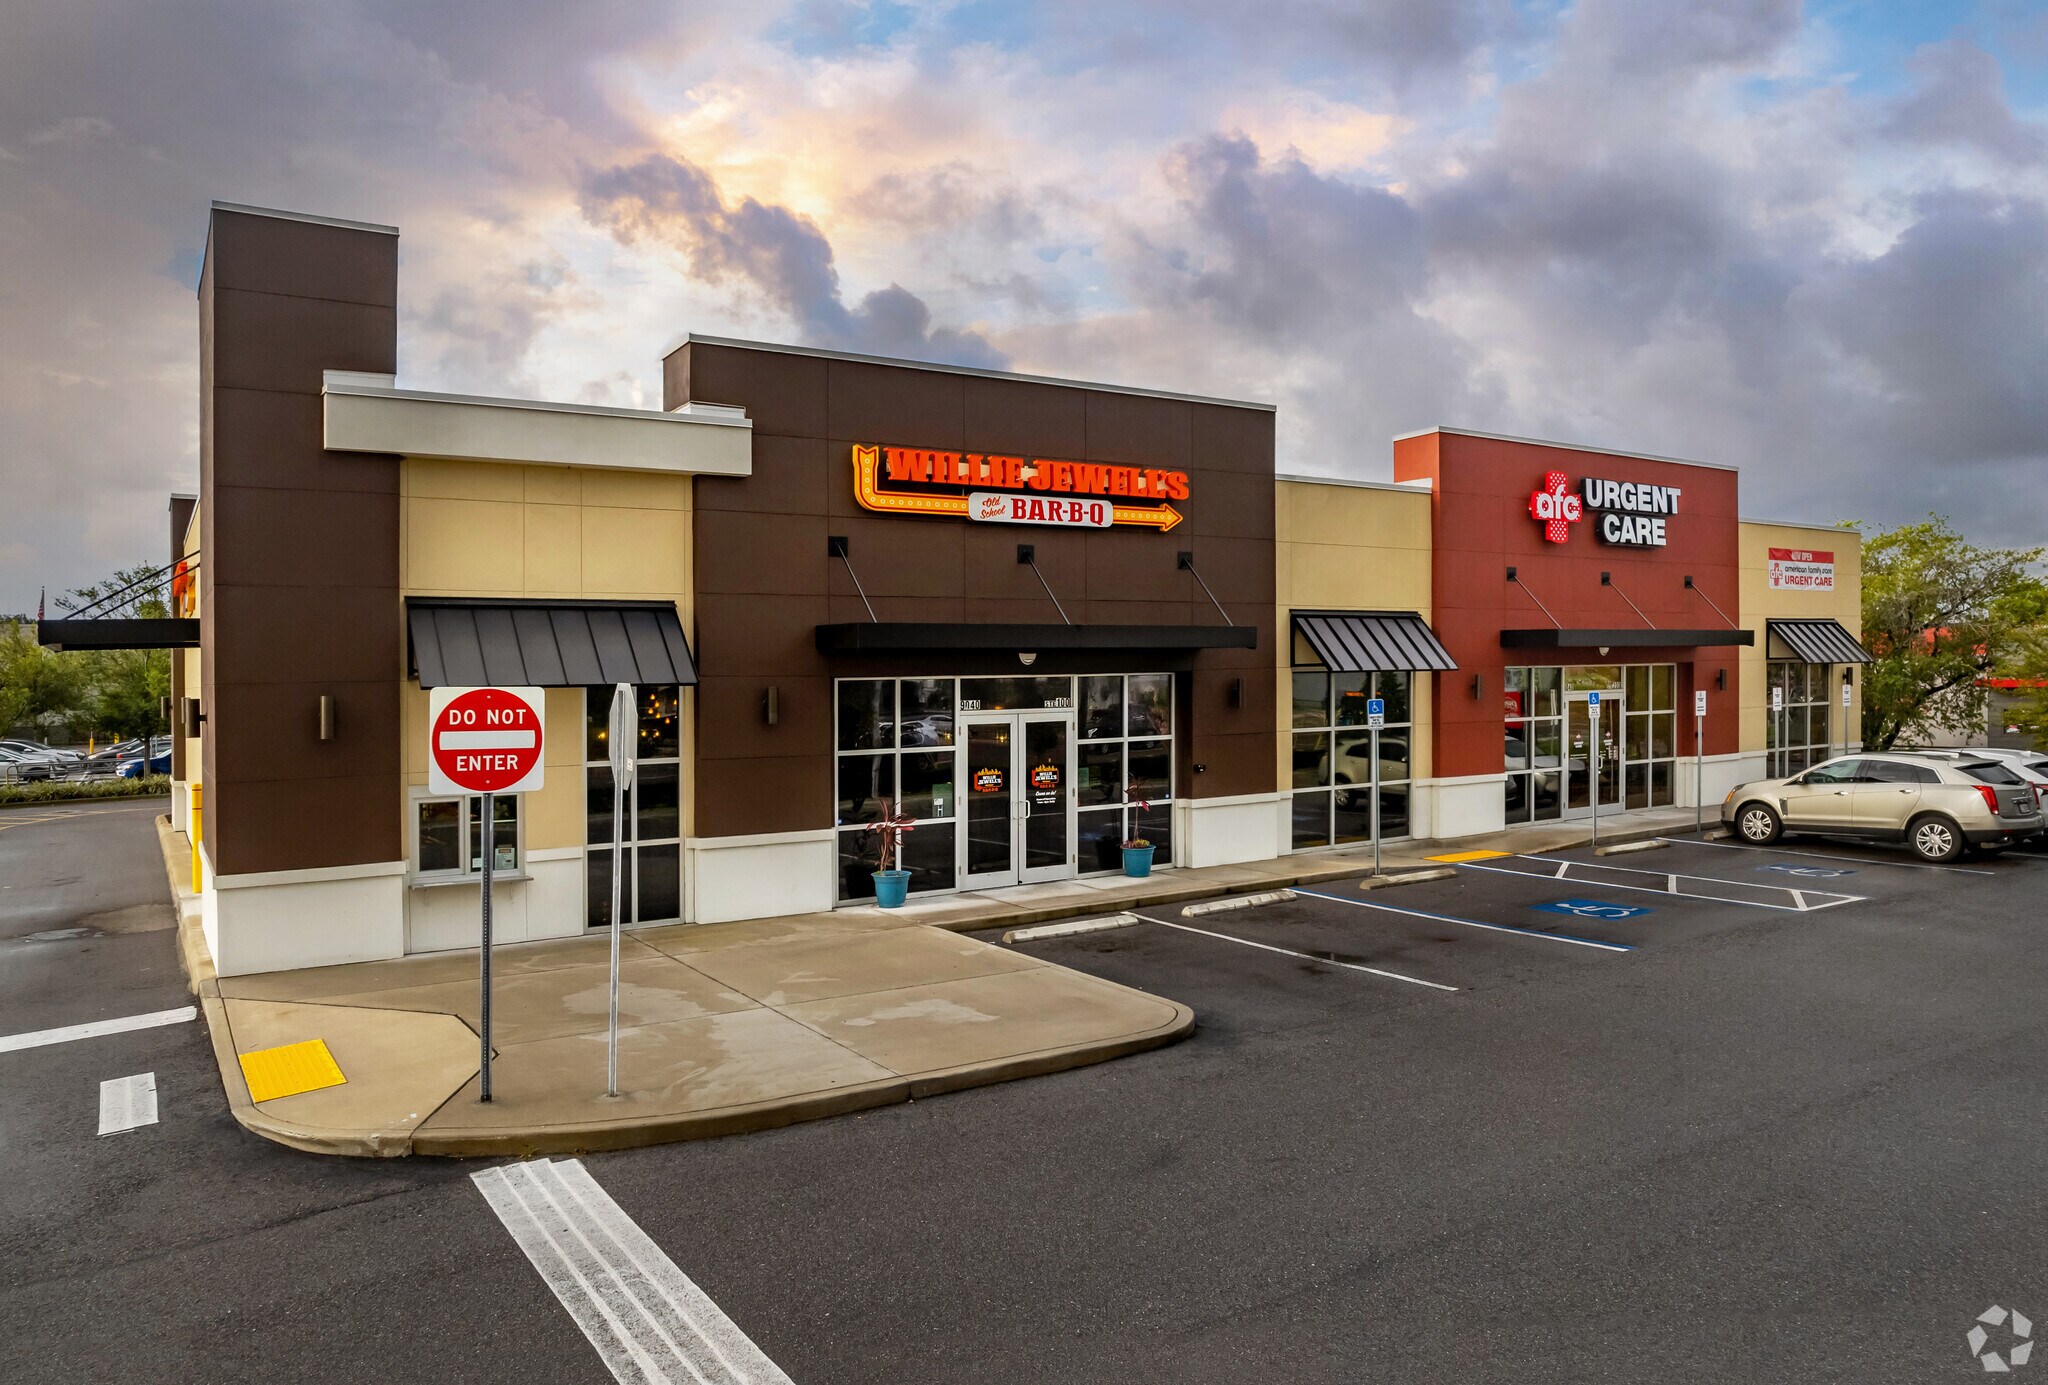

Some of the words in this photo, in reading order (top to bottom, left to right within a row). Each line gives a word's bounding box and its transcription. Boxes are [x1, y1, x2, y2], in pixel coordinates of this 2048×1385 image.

[883, 447, 1025, 488] WILLIE
[982, 496, 1001, 507] Old
[1537, 484, 1579, 520] afc
[1585, 478, 1681, 514] URGENT
[980, 505, 1006, 519] School
[1011, 498, 1104, 525] BAR-B-Q
[1604, 514, 1667, 545] CARE
[1801, 552, 1813, 561] OPEN
[1770, 567, 1783, 579] afc
[1808, 566, 1821, 575] family
[1785, 575, 1813, 585] URGENT
[1814, 577, 1832, 586] CARE
[960, 700, 980, 710] 9040
[449, 709, 476, 725] DO
[487, 709, 527, 725] NOT
[456, 755, 519, 771] ENTER
